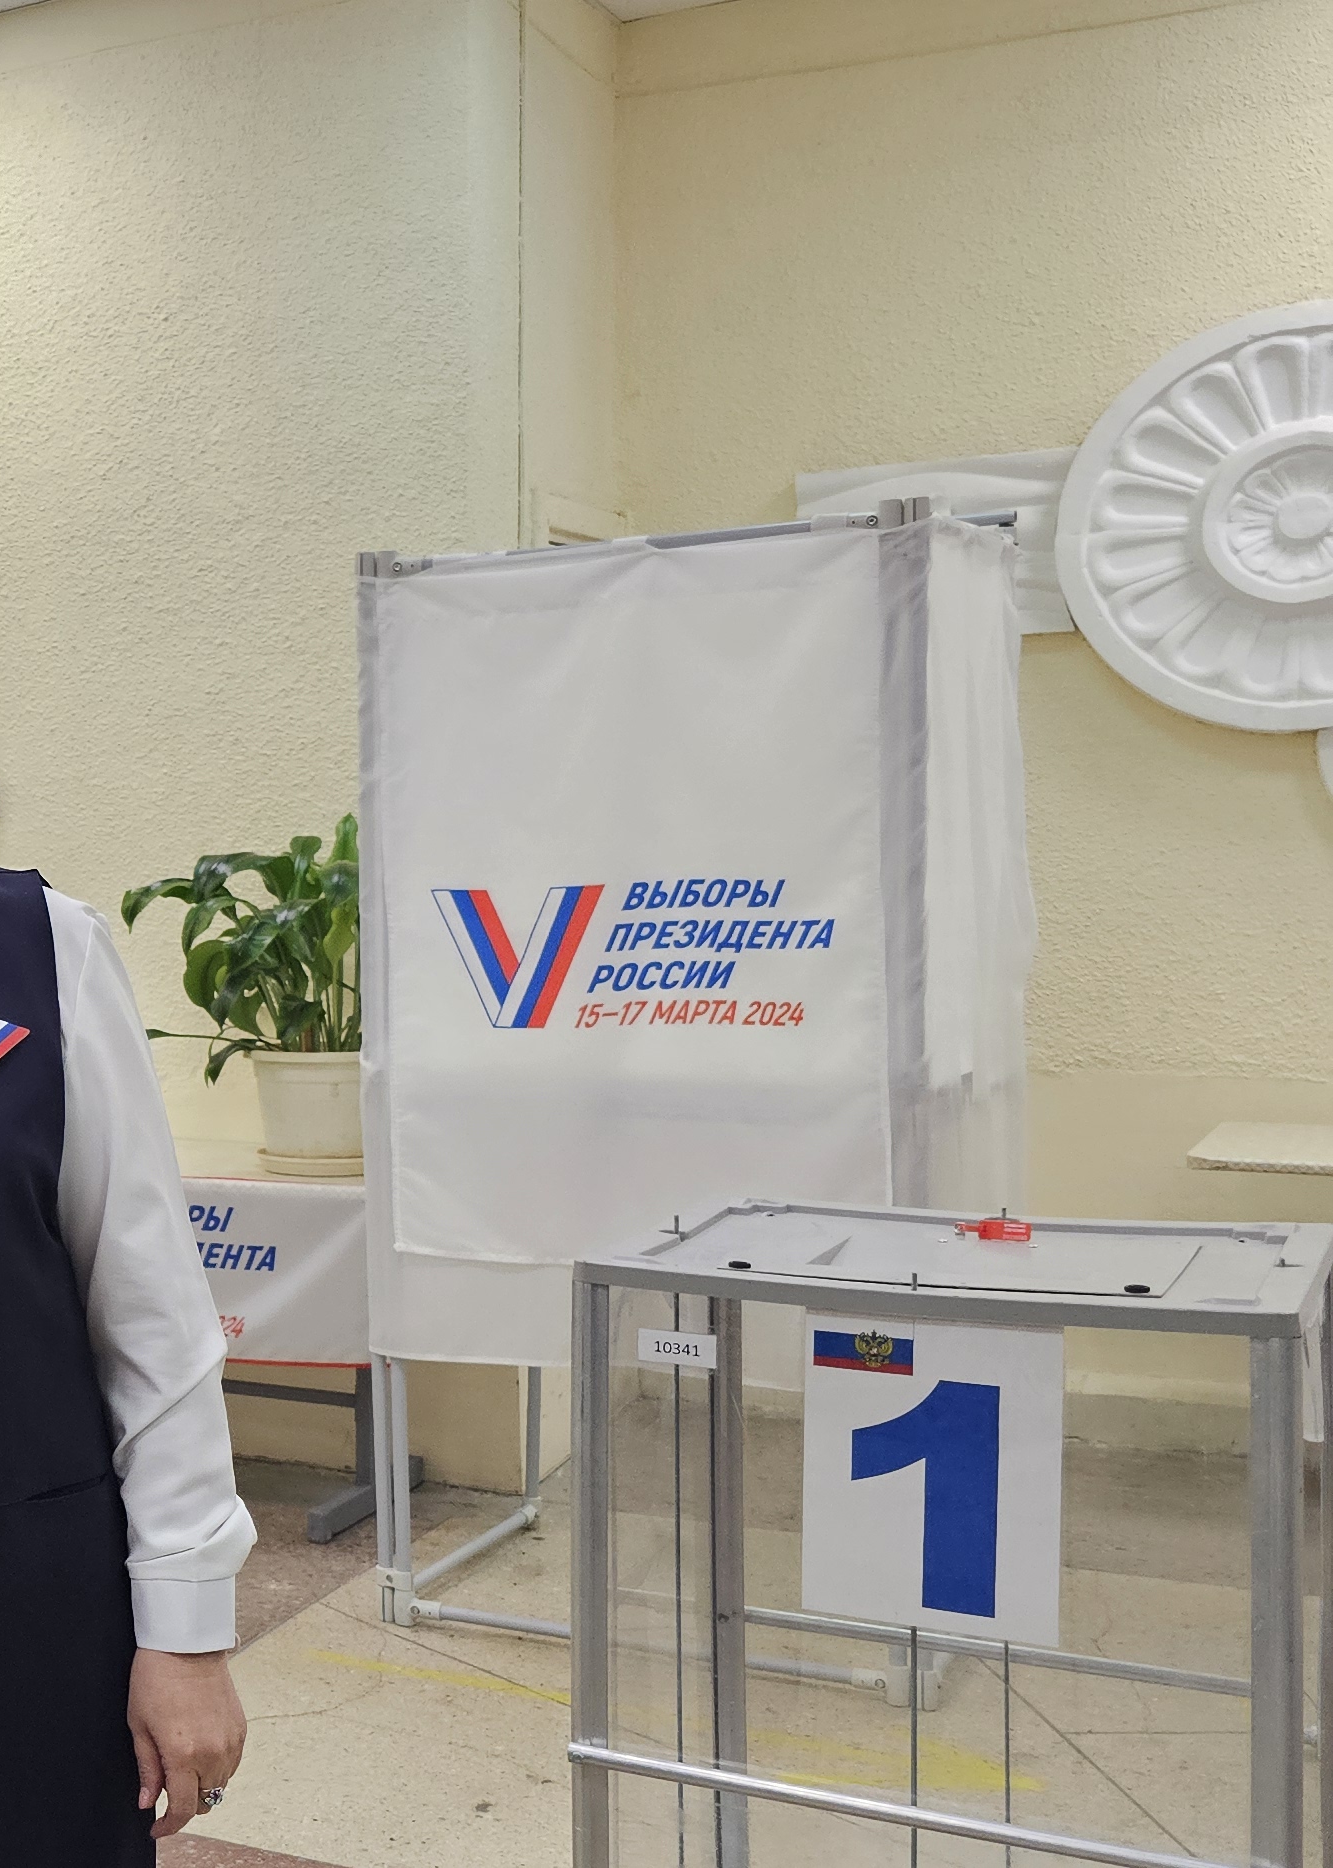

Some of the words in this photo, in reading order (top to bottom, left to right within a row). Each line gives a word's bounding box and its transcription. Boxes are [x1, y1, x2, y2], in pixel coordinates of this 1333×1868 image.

[621, 879, 785, 911] ВЫБОРЫ
[604, 919, 835, 953] ПРЕЗИДЕНТА
[587, 960, 736, 993] РОССИИ
[648, 1000, 737, 1025] МАРТА
[742, 1001, 804, 1026] 2024
[654, 1341, 700, 1357] 10341
[851, 1380, 1000, 1618] 1
